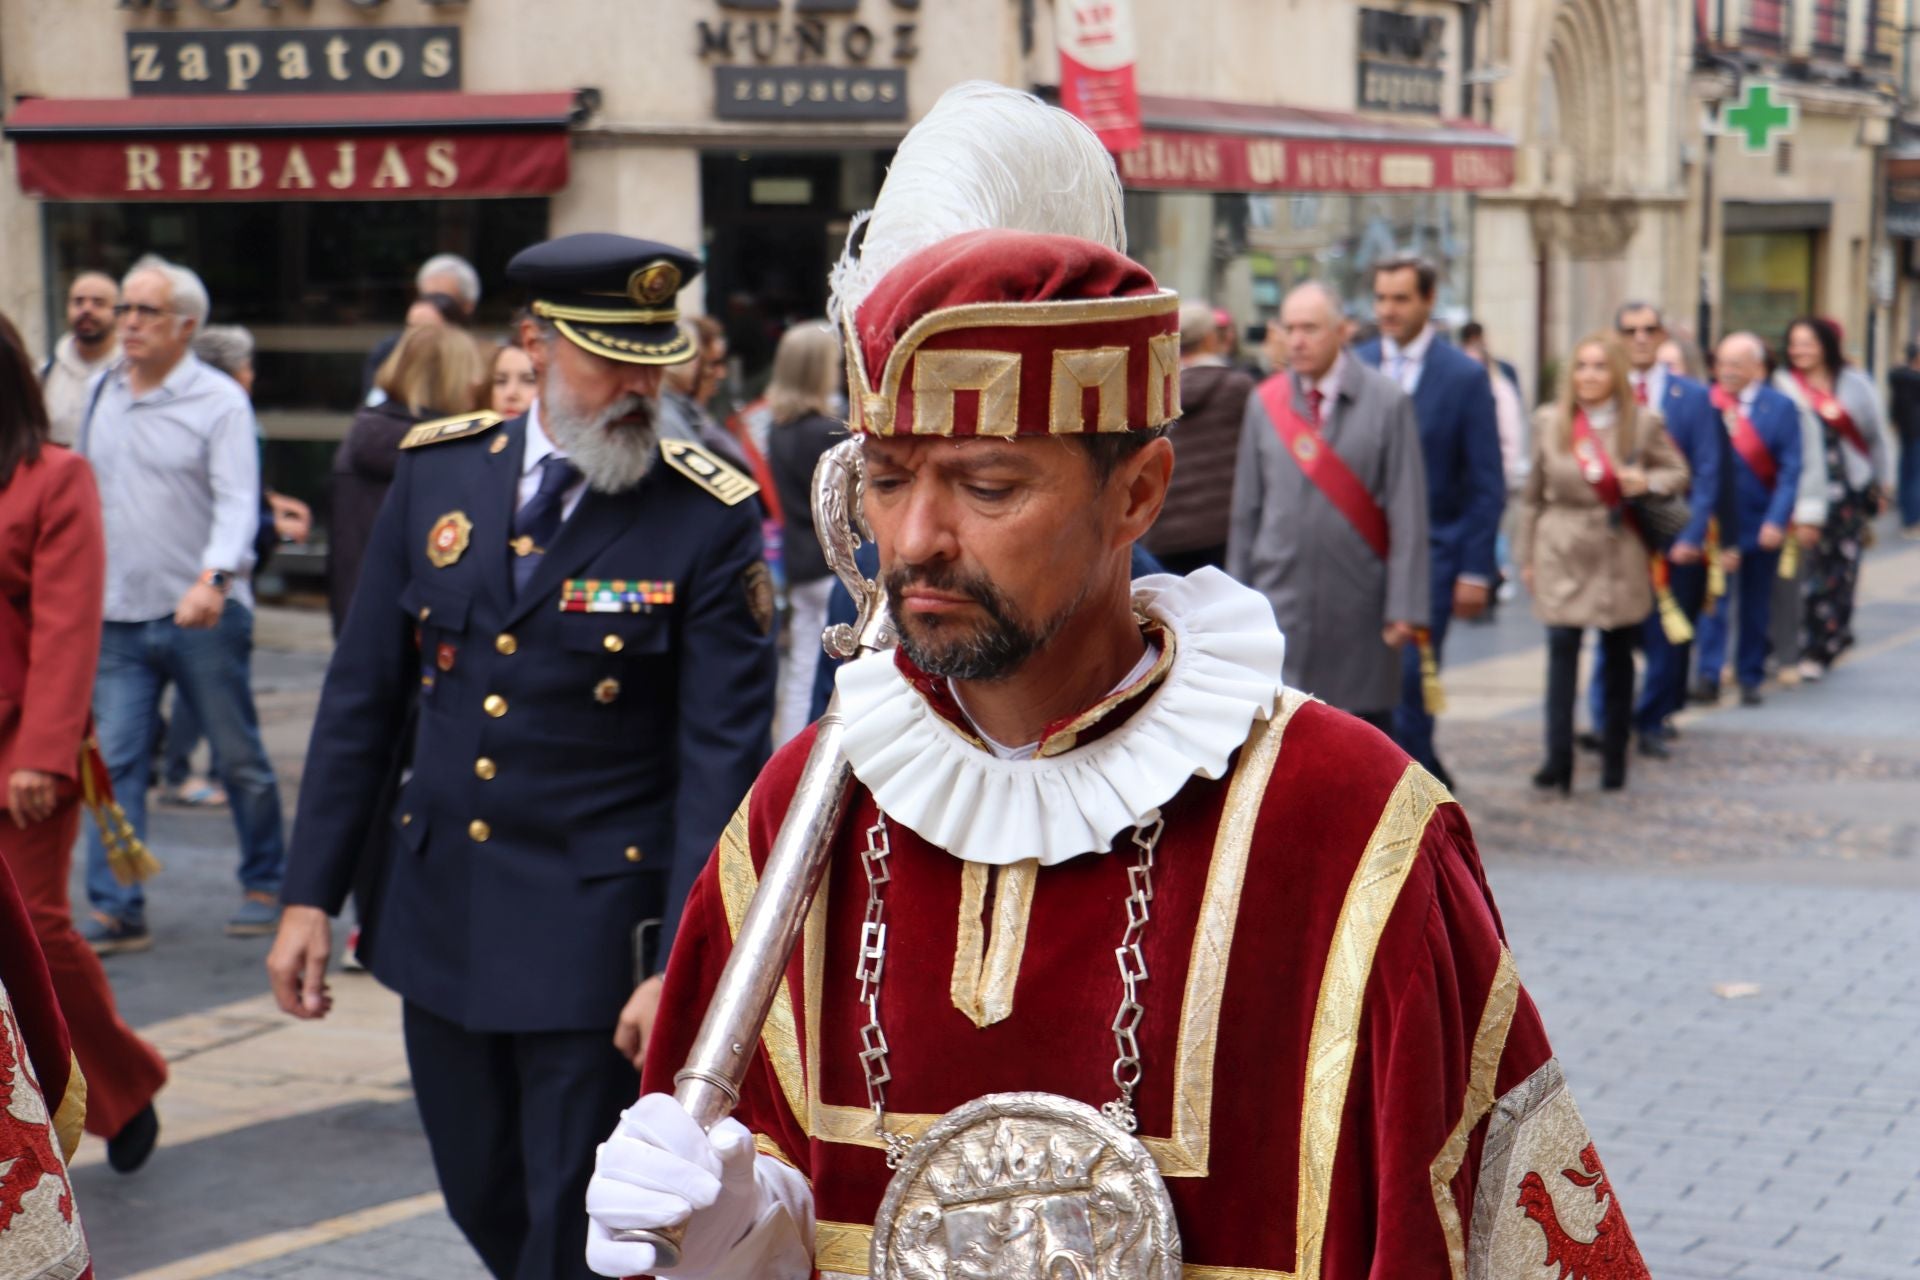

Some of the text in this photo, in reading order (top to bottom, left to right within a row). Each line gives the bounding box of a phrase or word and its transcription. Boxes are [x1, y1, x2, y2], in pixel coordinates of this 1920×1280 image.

[130, 37, 453, 91] zapatos
[733, 79, 896, 106] zapatos
[126, 140, 460, 190] REBAJAS
